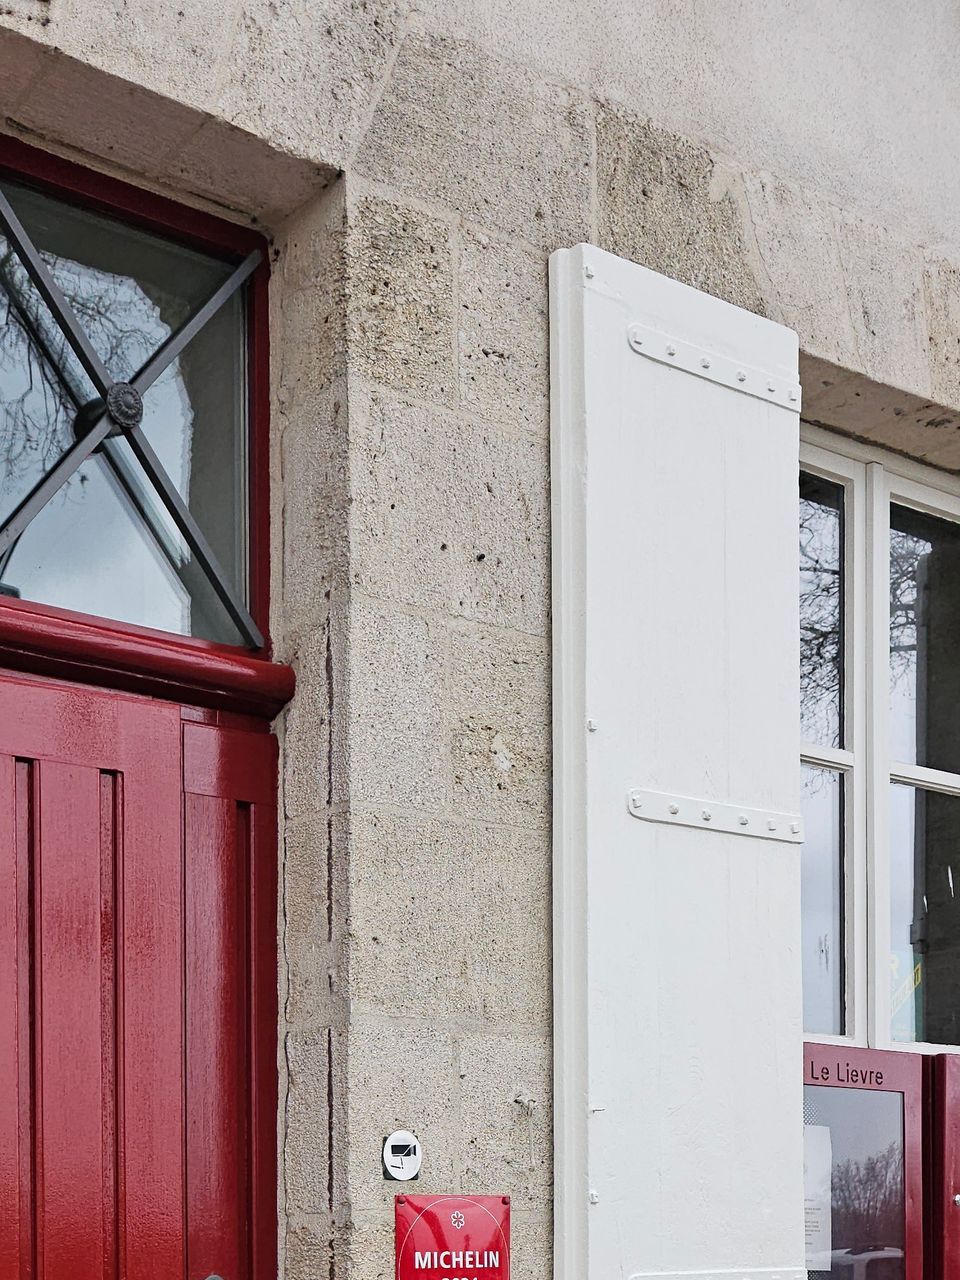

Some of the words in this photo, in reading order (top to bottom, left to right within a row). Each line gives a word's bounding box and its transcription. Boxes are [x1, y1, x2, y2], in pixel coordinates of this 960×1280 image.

[810, 1060, 830, 1081] Le
[836, 1062, 884, 1085] Lievre
[414, 1250, 500, 1269] MICHELIN
